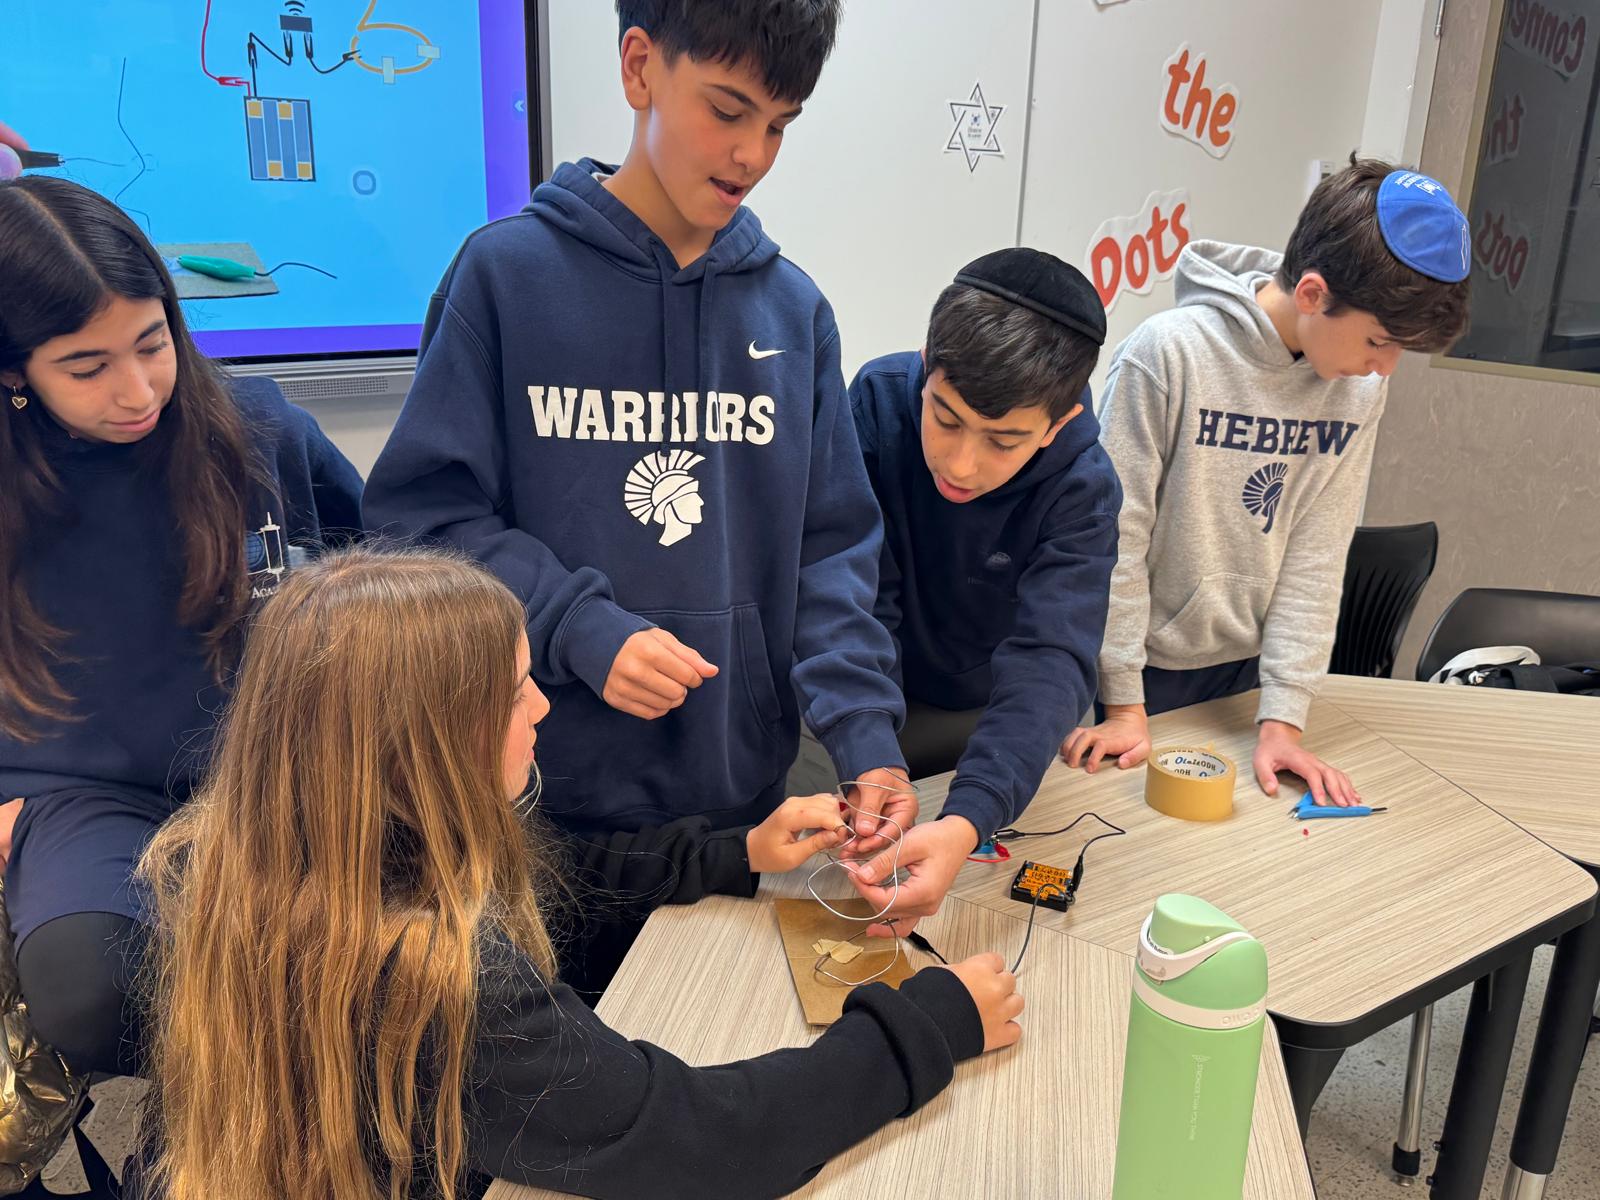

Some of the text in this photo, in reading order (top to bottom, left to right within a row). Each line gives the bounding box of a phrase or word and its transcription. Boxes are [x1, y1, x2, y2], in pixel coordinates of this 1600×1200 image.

[1164, 49, 1236, 147] the
[527, 385, 775, 446] WARRIORS
[1195, 408, 1360, 456] HEBREW
